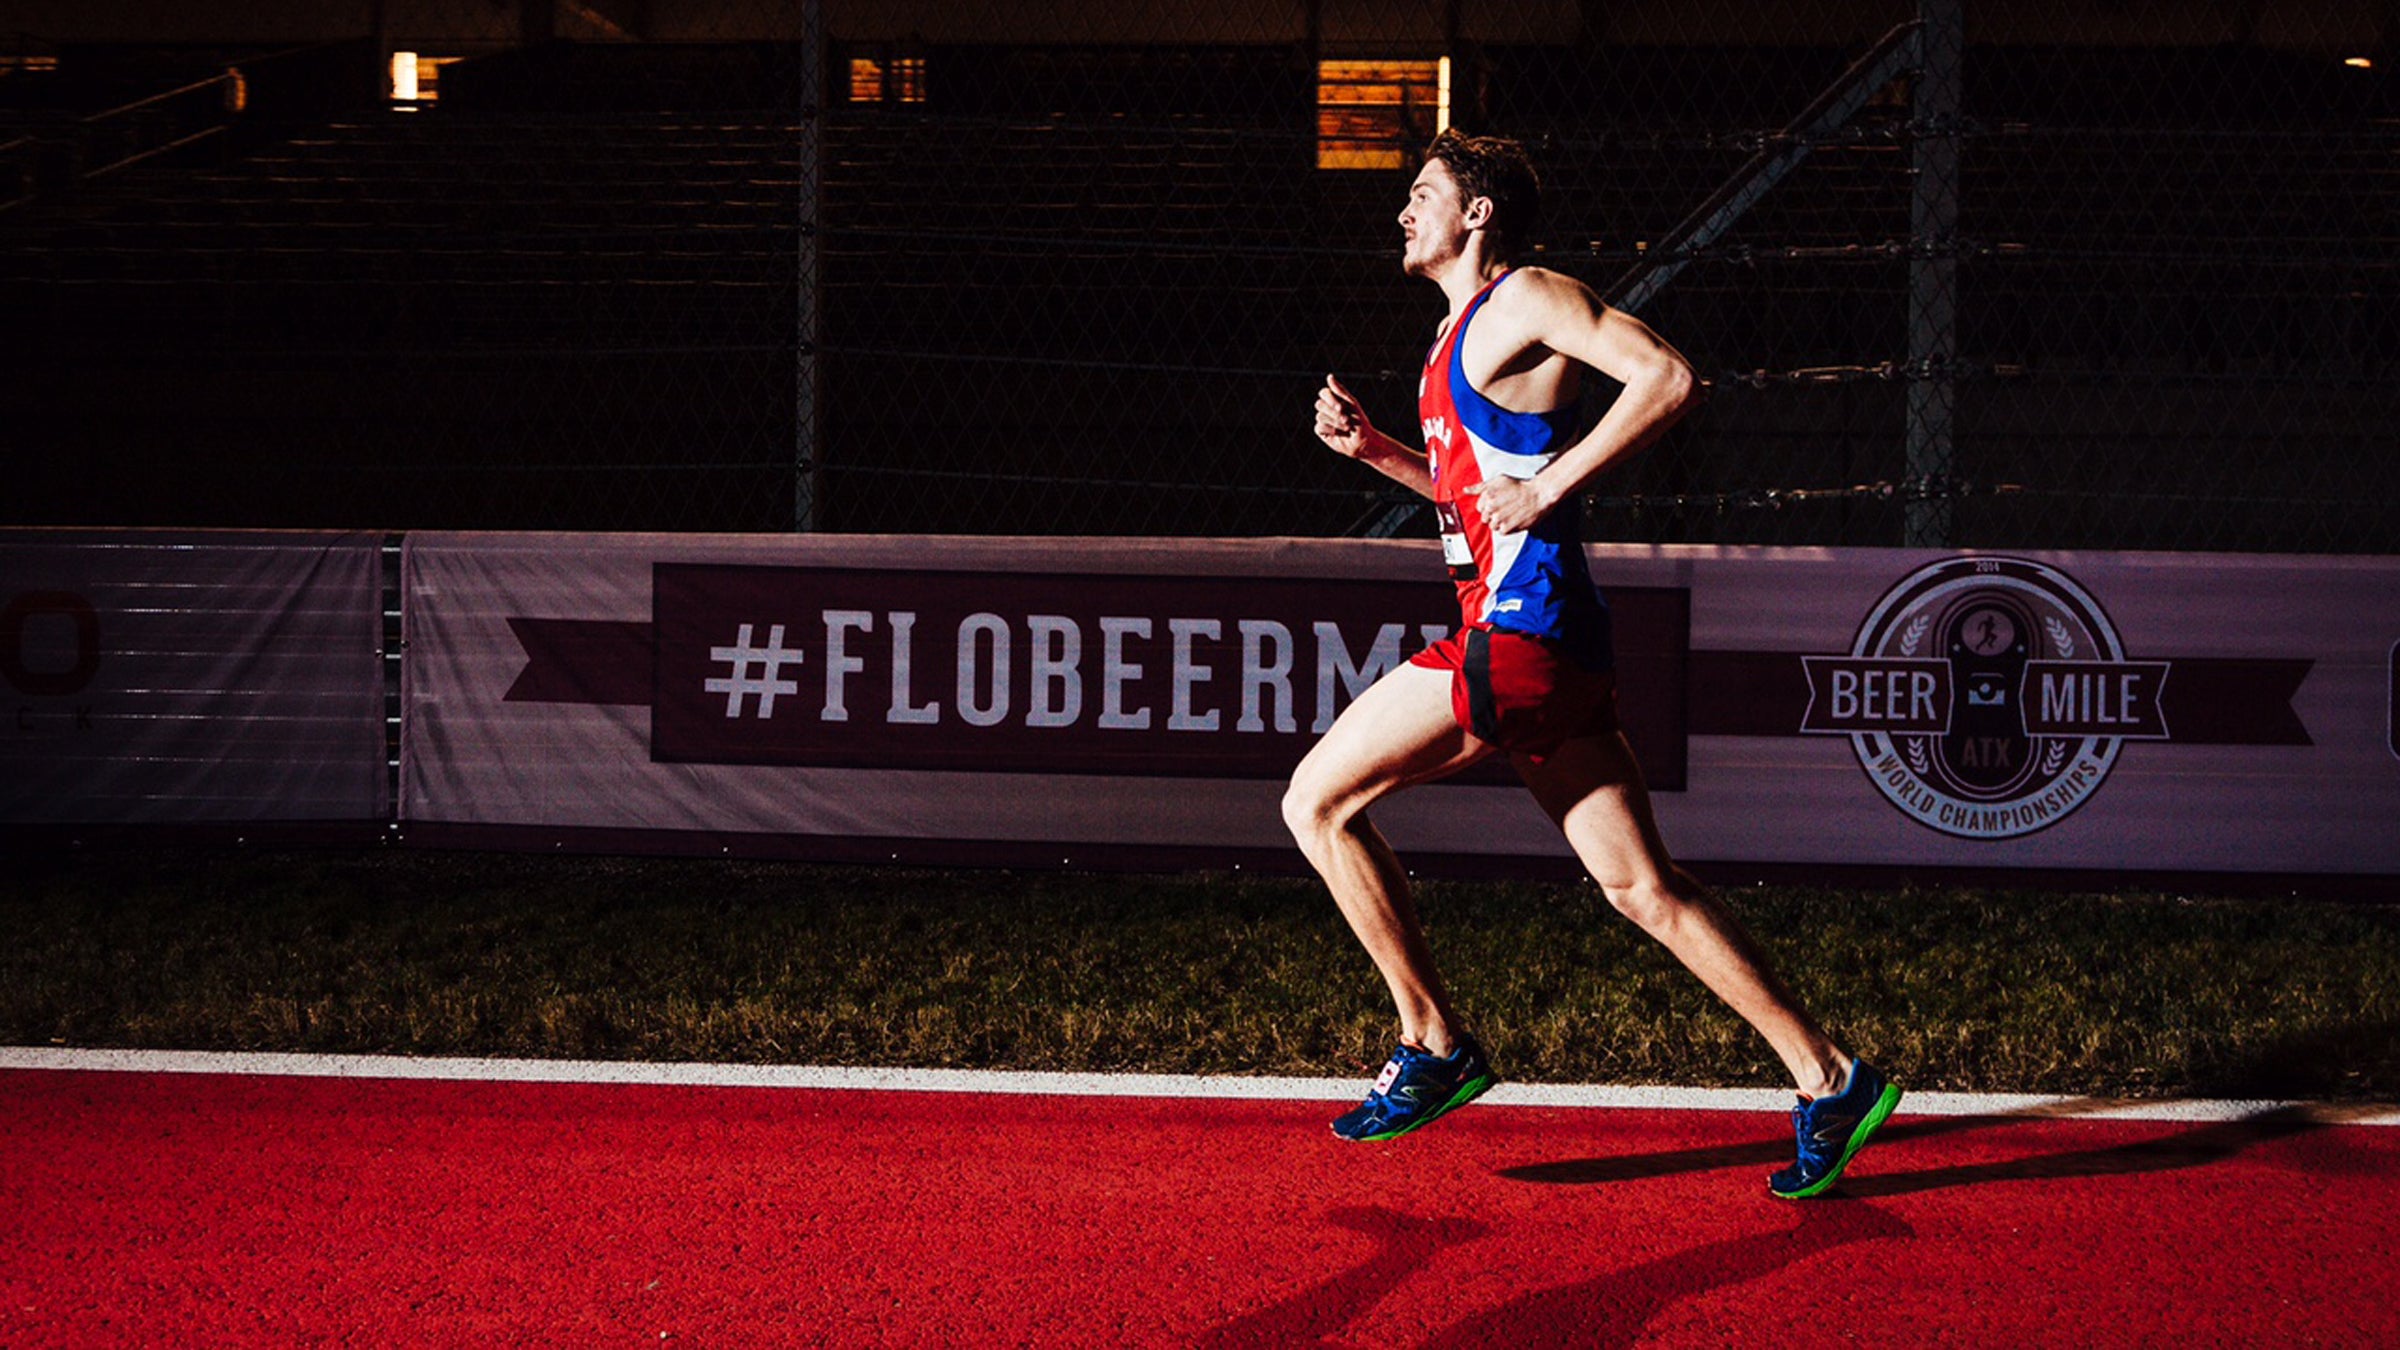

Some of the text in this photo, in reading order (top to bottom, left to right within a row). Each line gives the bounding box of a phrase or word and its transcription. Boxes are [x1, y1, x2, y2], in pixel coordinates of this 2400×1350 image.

[1975, 561, 2001, 573] 2014
[704, 609, 1449, 735] #FLOBEERM
[1831, 669, 2141, 724] BEER MILE
[1961, 736, 2012, 769] ATX
[1877, 754, 2099, 832] WORLD CHAMPIONSHIPS
